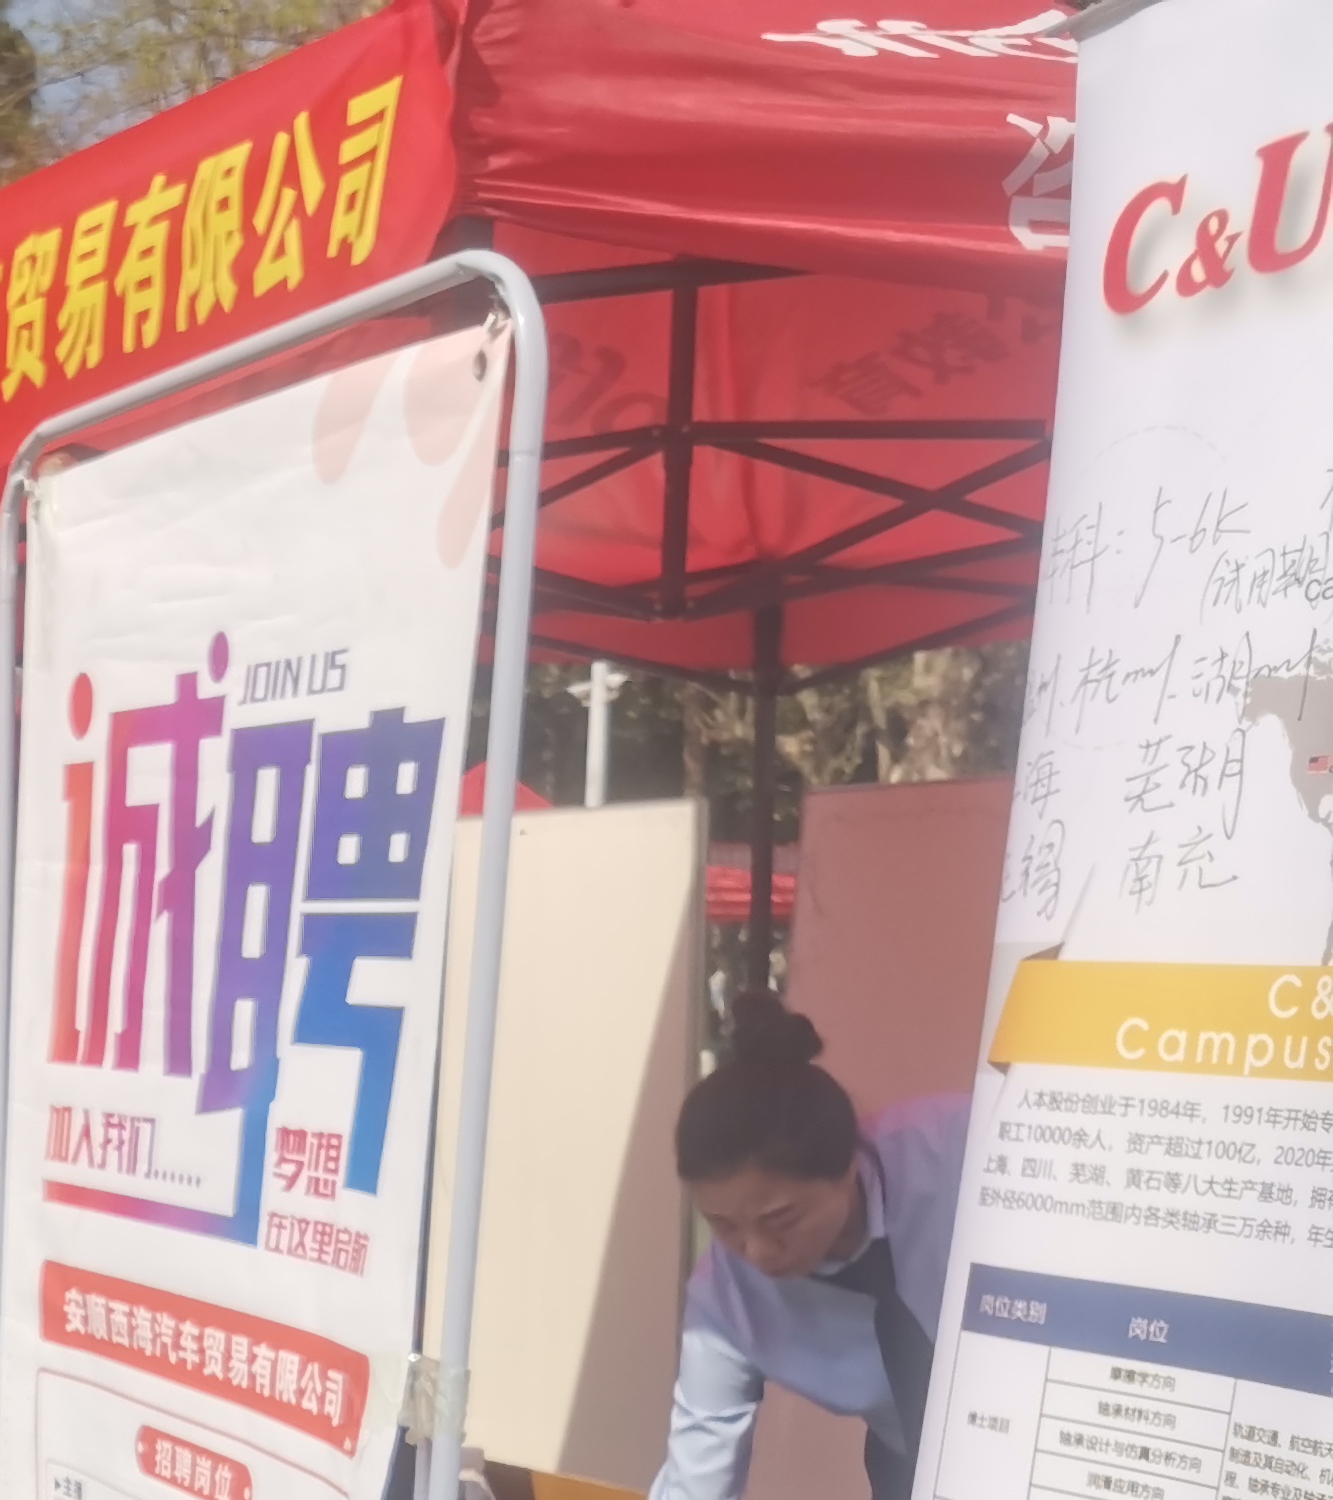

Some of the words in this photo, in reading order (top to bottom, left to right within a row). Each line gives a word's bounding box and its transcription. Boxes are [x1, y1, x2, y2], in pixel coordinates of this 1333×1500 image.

[238, 658, 303, 705] JOIN
[306, 648, 350, 694] US
[45, 631, 446, 1248] 诚聘
[1116, 1016, 1333, 1076] Campus
[272, 1125, 342, 1201] 梦想
[264, 1211, 370, 1278] 在这里启航
[62, 1287, 346, 1427] 安顺西海汽车贸易有限公司
[1128, 1316, 1170, 1344] 岗位
